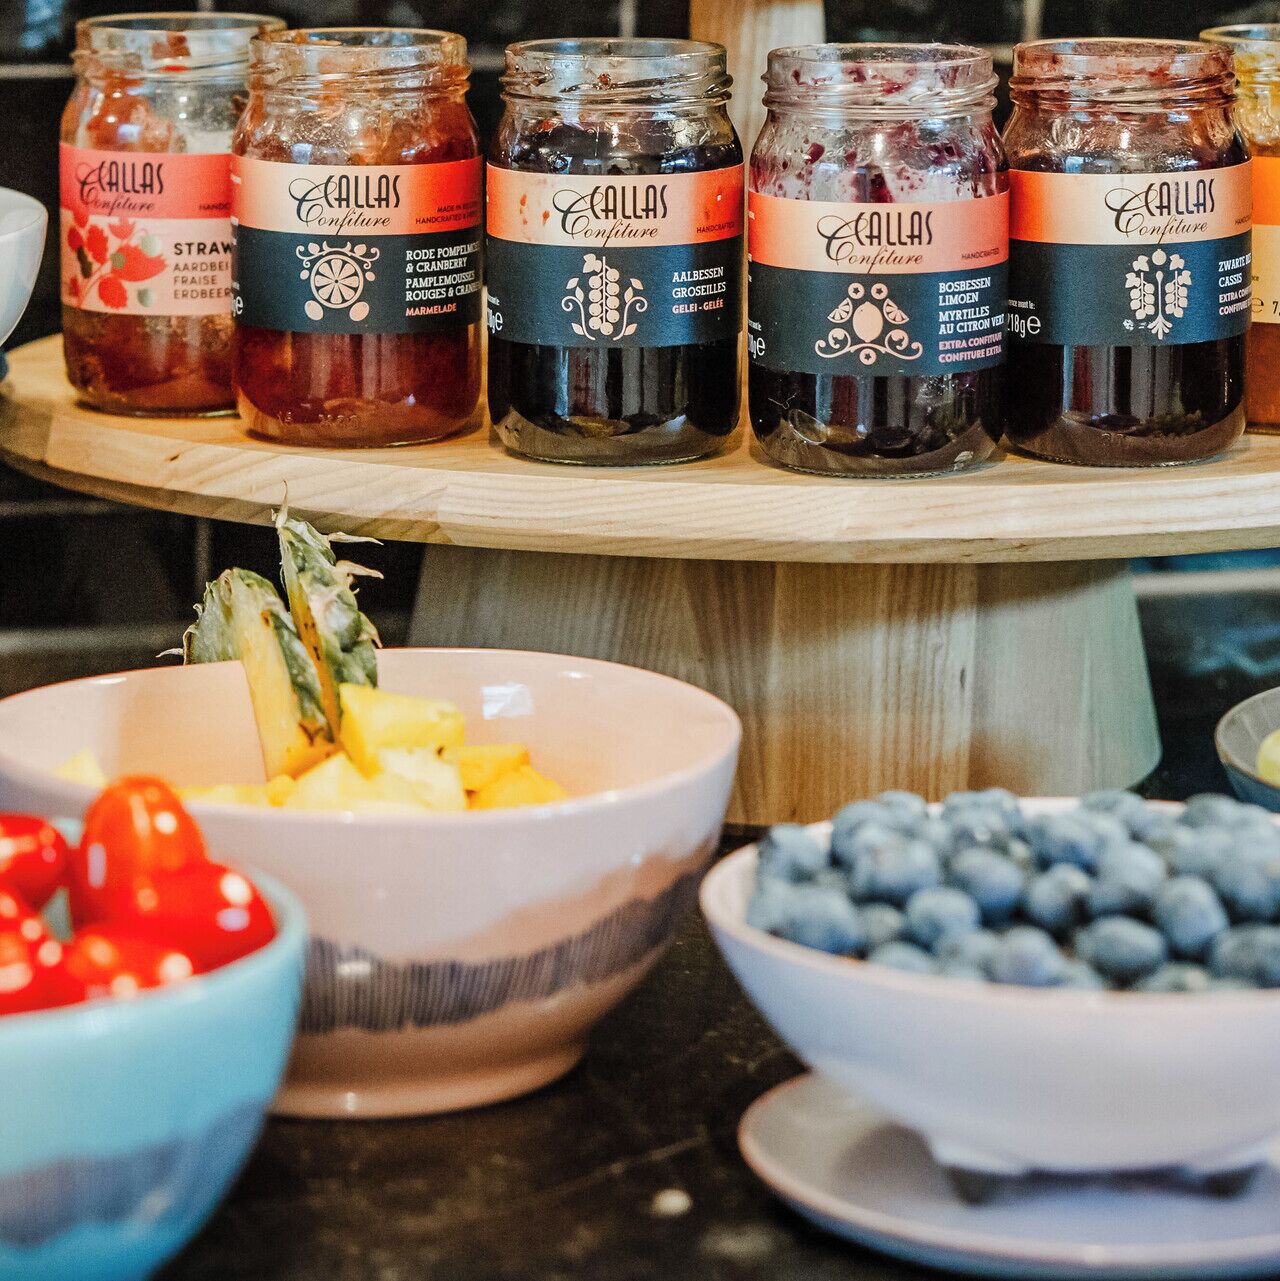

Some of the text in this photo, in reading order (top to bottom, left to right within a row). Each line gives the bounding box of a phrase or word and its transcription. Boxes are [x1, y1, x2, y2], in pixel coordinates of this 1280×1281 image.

[98, 160, 164, 195] CALLAS
[323, 174, 401, 210] CALLAS
[1144, 178, 1215, 217] CALLAS
[589, 184, 668, 220] CALLAS
[854, 210, 933, 246] CALLAS
[405, 248, 436, 261] RODE
[405, 257, 468, 273] & CRANBERRY
[1218, 255, 1246, 272] ZWARTE
[173, 275, 218, 285] FRAISE
[672, 266, 724, 283] AALBESSEN
[1218, 273, 1243, 288] CASSIS
[672, 281, 727, 299] GROSEILLES
[938, 276, 992, 294] BOSBESSEN
[405, 288, 447, 302] ROUGES
[448, 286, 454, 297] &
[938, 291, 979, 307] LIMOEN
[1218, 291, 1239, 304] EXTRA
[405, 303, 457, 317] MARMELADE
[672, 302, 698, 314] GELEI
[938, 305, 990, 322] MYRTILLES
[938, 322, 954, 335] AU
[956, 318, 990, 333] CITRON
[938, 338, 968, 351] EXTRA
[938, 350, 986, 363] CONFITURE
